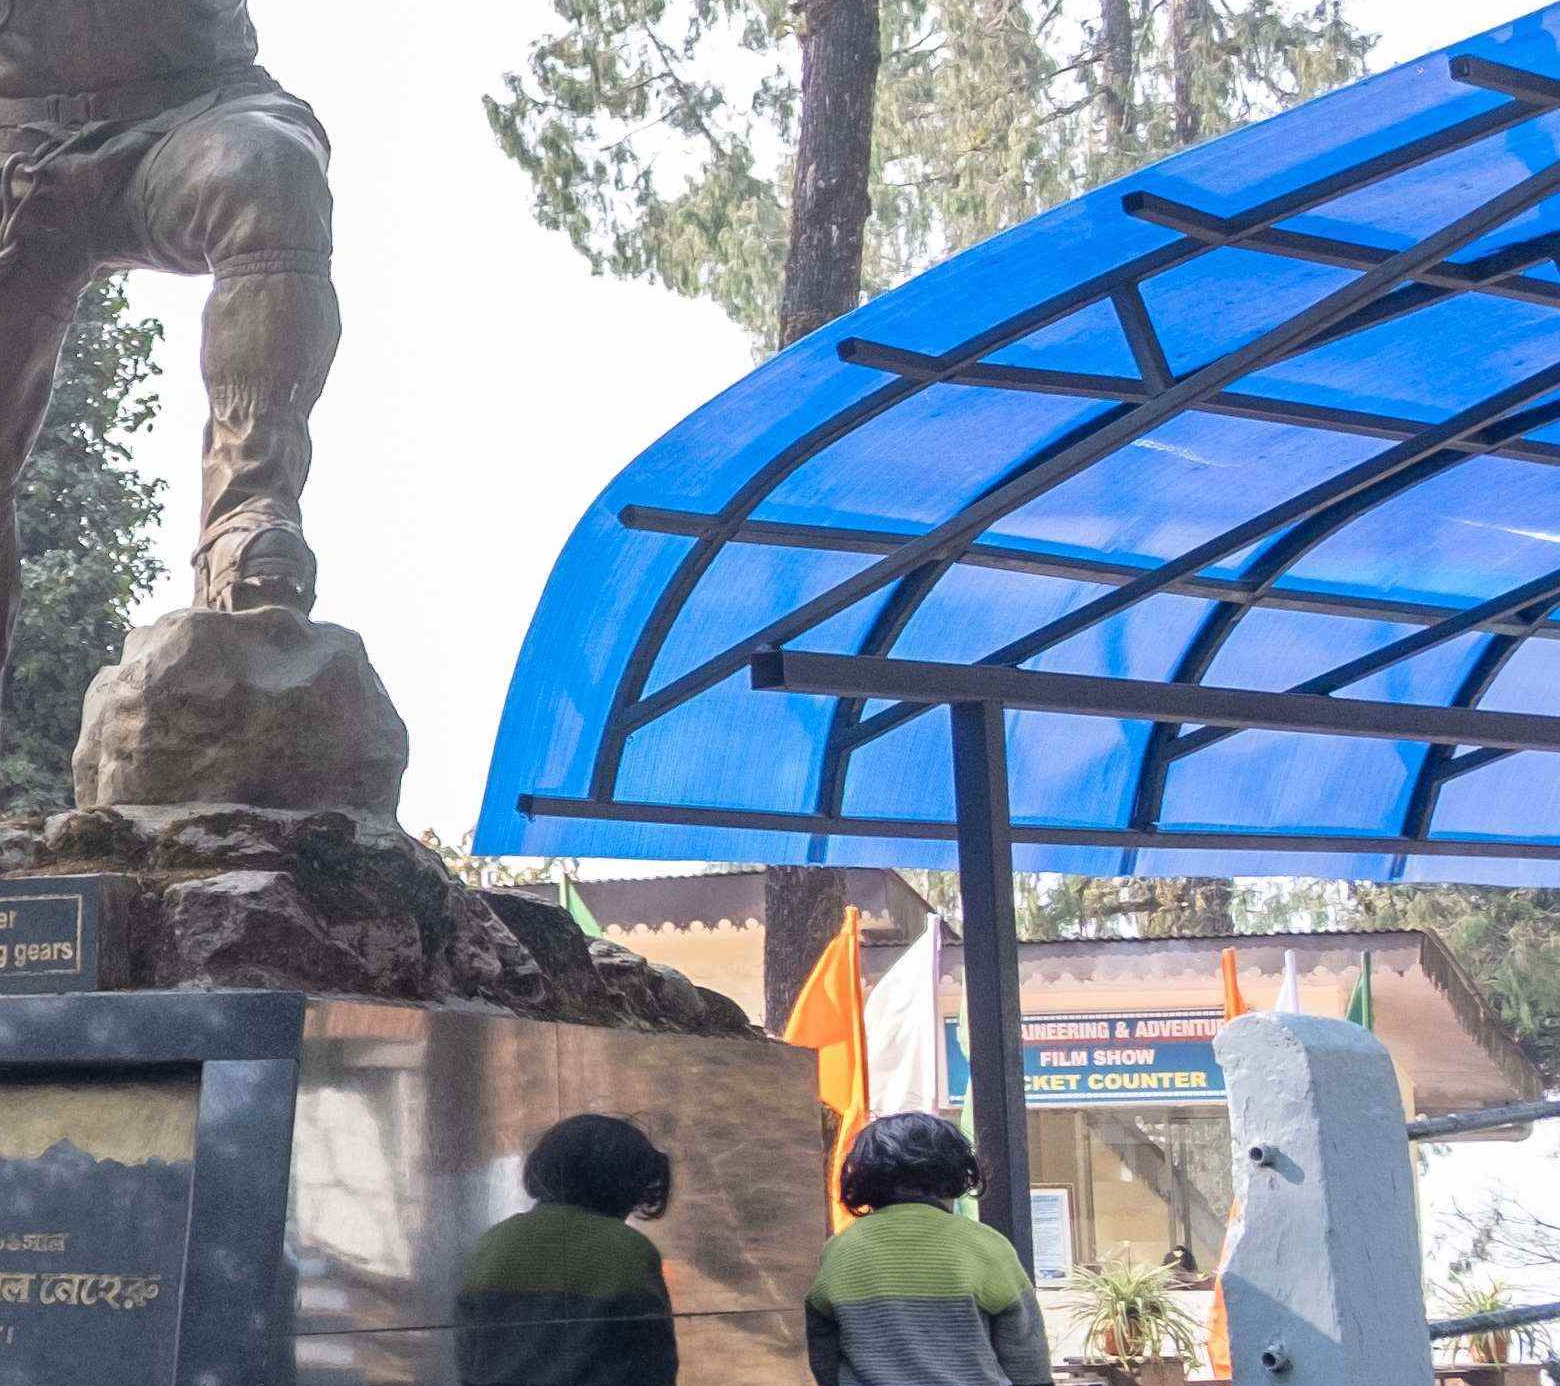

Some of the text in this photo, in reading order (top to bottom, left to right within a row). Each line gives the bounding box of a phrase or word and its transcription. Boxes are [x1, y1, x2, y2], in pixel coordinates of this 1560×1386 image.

[14, 940, 74, 967] gears
[1115, 1021, 1130, 1039] &
[1040, 1048, 1156, 1067] FILM SHOW
[1088, 1071, 1208, 1090] COUNTER
